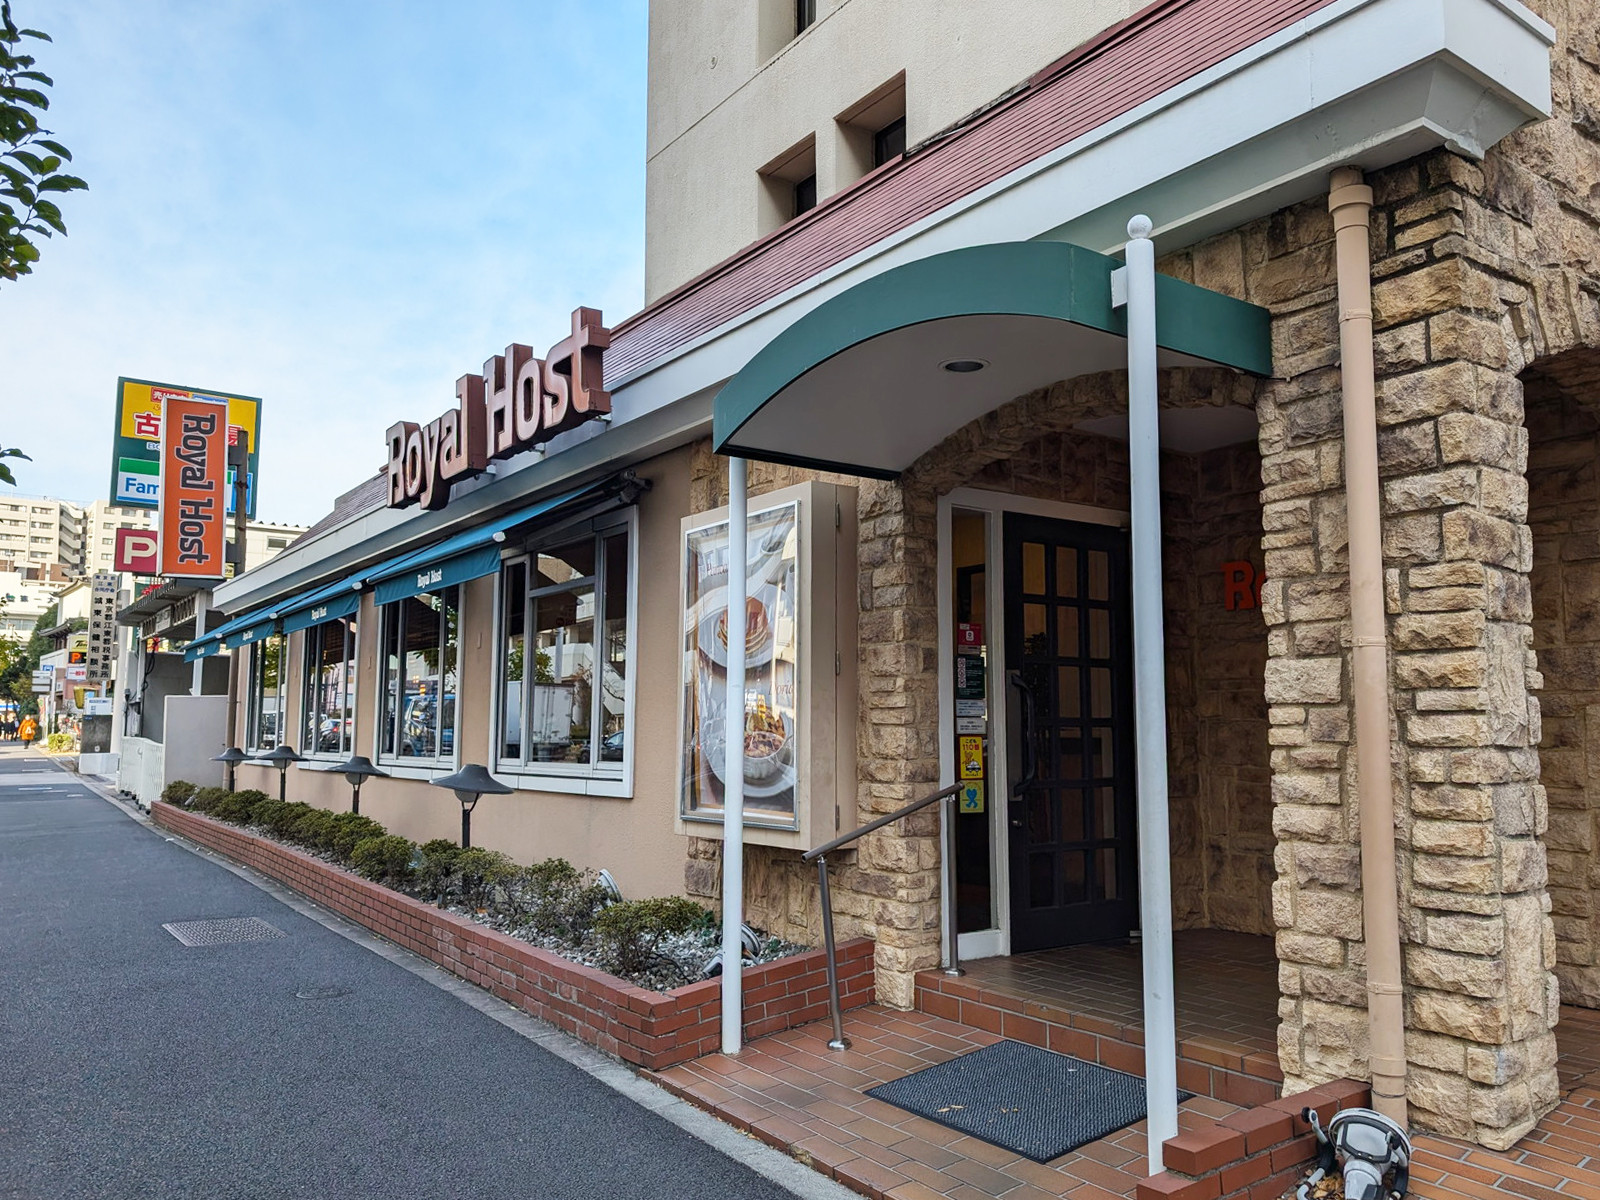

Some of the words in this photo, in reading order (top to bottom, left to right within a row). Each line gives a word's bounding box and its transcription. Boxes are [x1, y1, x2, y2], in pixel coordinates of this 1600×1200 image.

[386, 374, 487, 511] Royal
[483, 306, 611, 460] Host
[175, 413, 217, 491] Royal
[123, 535, 157, 564] P
[178, 497, 214, 564] Host
[100, 597, 114, 678] 東京都江東都税事務所
